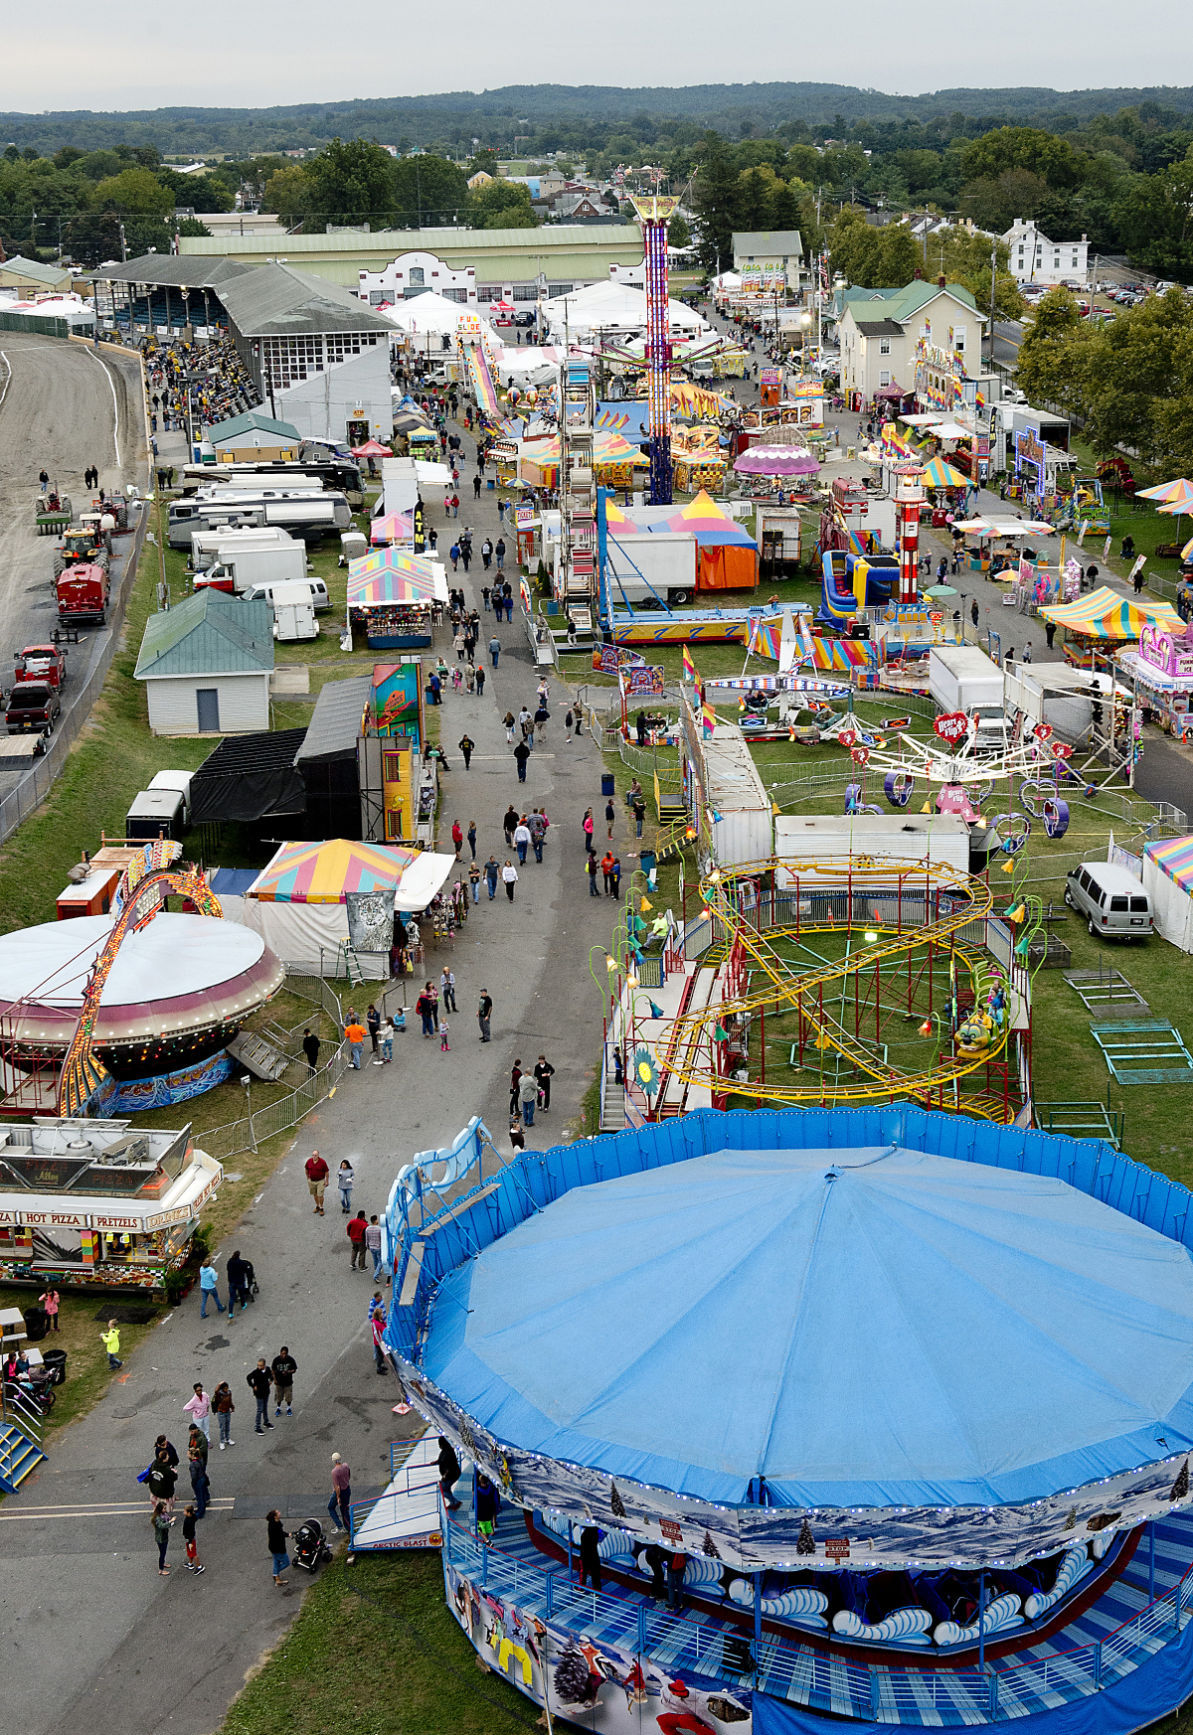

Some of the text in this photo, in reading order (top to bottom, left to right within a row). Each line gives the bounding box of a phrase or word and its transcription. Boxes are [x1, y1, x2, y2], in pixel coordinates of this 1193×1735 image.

[517, 511, 534, 519] TICKETS
[415, 511, 425, 544] ATM
[26, 1213, 81, 1225] HOT PIZZA
[97, 1217, 138, 1228] PRETZELS
[149, 1209, 189, 1228] DRINKS
[373, 1539, 428, 1549] ARCTIC BLAST
